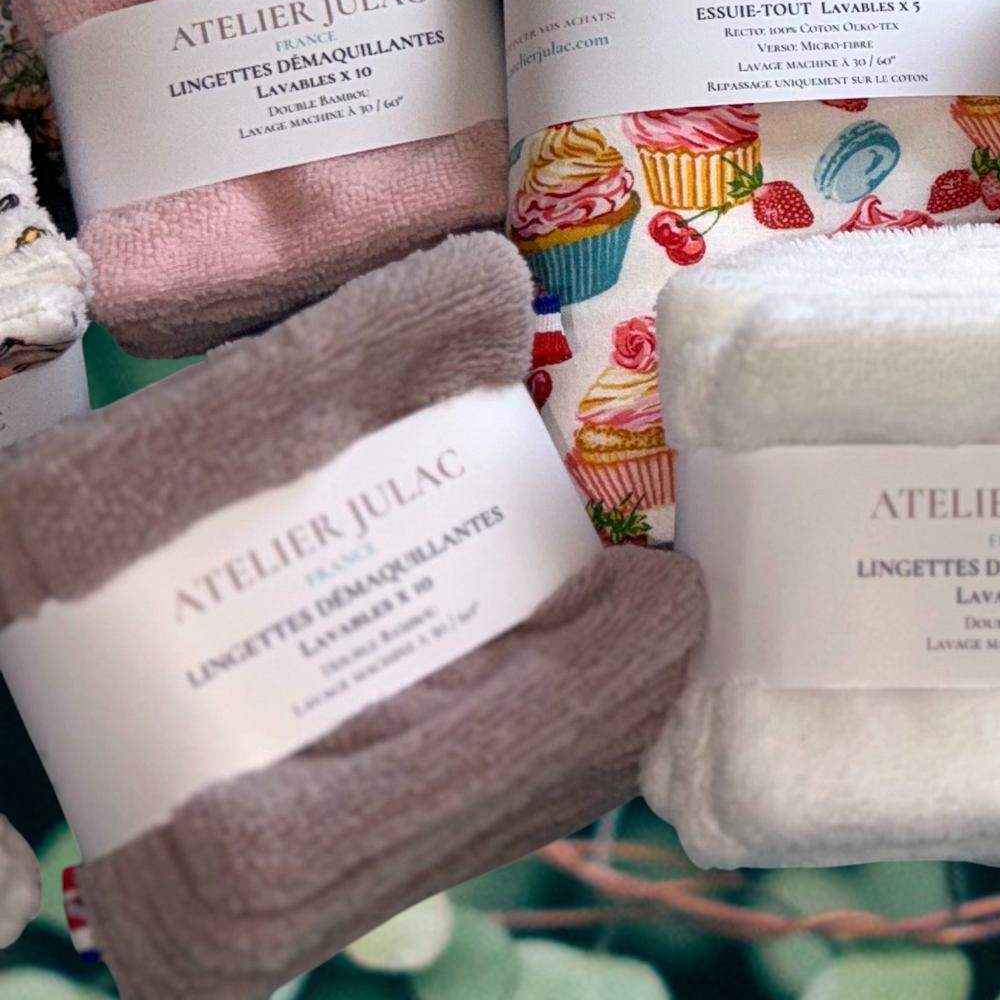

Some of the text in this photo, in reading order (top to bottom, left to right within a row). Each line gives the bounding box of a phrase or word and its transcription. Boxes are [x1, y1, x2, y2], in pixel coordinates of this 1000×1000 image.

[696, 2, 812, 21] ESSUIE-TOUT
[822, 1, 895, 15] LAVABLES
[912, 1, 921, 13] 5
[171, 1, 314, 51] ATELIER
[800, 23, 839, 35] COTON
[275, 30, 336, 52] FRANCE
[801, 39, 874, 51] MICRO-FIBRE
[169, 30, 445, 98] LINGETTES DÉMAQUILLANTES
[738, 60, 782, 72] LAVAGE
[786, 58, 838, 70] MACHINE
[256, 74, 336, 99] LAVABLES
[356, 67, 372, 79] 10
[707, 72, 929, 92] REPASSAGE UNIQUEMENT SUR LE COTON
[268, 89, 369, 117] DOUBLE BAMBOU
[239, 121, 287, 139] LAVAGE
[290, 109, 344, 129] MACHINE
[375, 99, 381, 114] /
[174, 448, 466, 625] ATELIER JULAC
[304, 542, 377, 588] FRANCE
[857, 559, 979, 578] LINGETTES
[185, 609, 315, 689] LINGETTES
[315, 505, 505, 618] DÉMAQUILLANTES
[926, 637, 982, 651] LAVAGE
